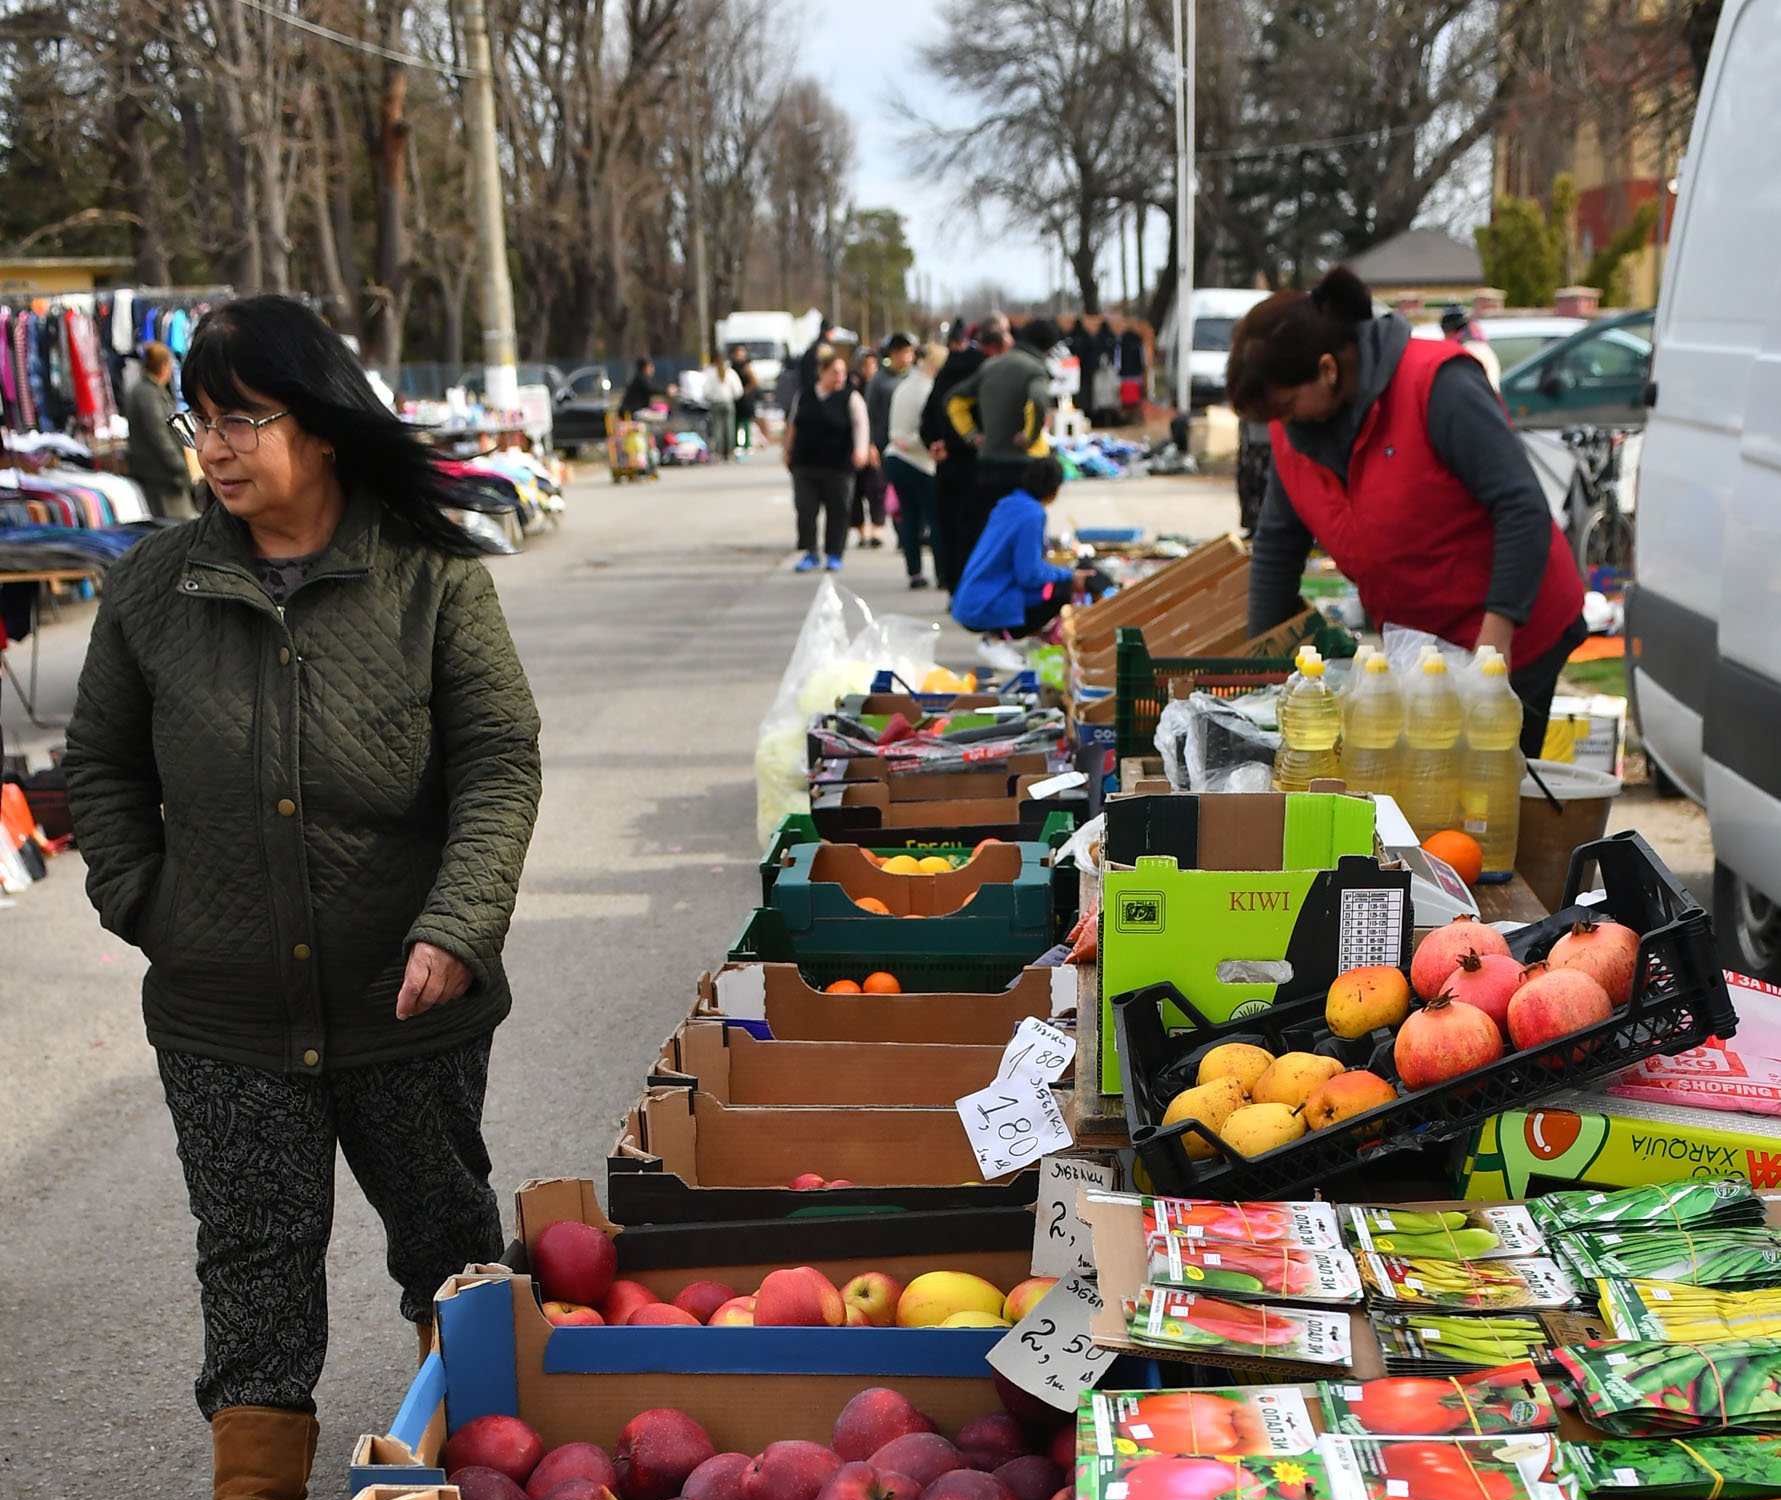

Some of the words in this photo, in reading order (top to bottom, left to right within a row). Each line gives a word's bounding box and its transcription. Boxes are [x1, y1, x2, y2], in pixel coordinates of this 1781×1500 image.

[1229, 891, 1290, 912] KIWI
[1673, 1056, 1717, 1070] kg
[1678, 1079, 1773, 1097] SHOPING
[1631, 1133, 1739, 1167] XARQUÍA
[1294, 1213, 1312, 1234] ОПАЛ
[1494, 1219, 1517, 1238] ОПАЛ
[1506, 1238, 1522, 1249] ЗИ
[1300, 1235, 1316, 1246] ЗИ
[1314, 1254, 1333, 1275] ОПАЛ
[1321, 1276, 1337, 1290] ЗИ
[1307, 1320, 1323, 1342] ОПАЛ
[1308, 1343, 1324, 1355] ЗИ
[1262, 1408, 1280, 1436] ОПАЛ
[1270, 1437, 1289, 1450] ЗИ
